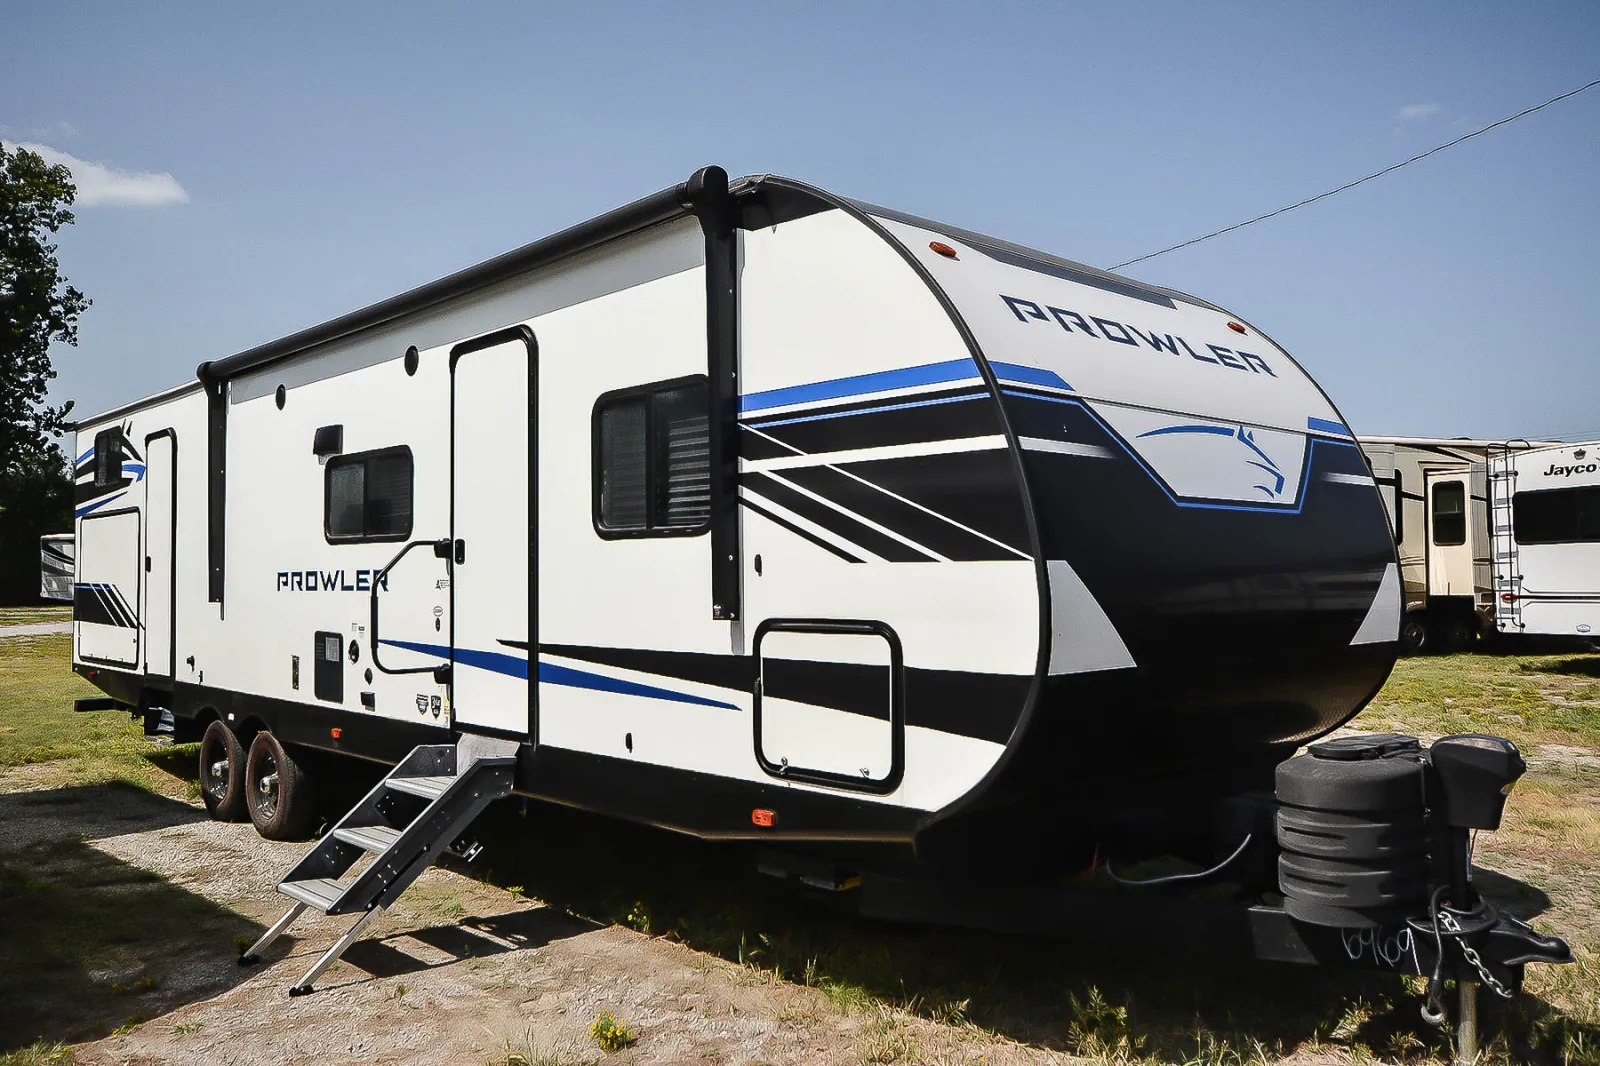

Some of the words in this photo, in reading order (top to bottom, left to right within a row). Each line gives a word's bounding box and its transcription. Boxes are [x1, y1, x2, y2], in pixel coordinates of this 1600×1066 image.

[1000, 294, 1278, 378] PROWLER
[1544, 464, 1597, 477] Jayco
[277, 570, 389, 592] PROWLER
